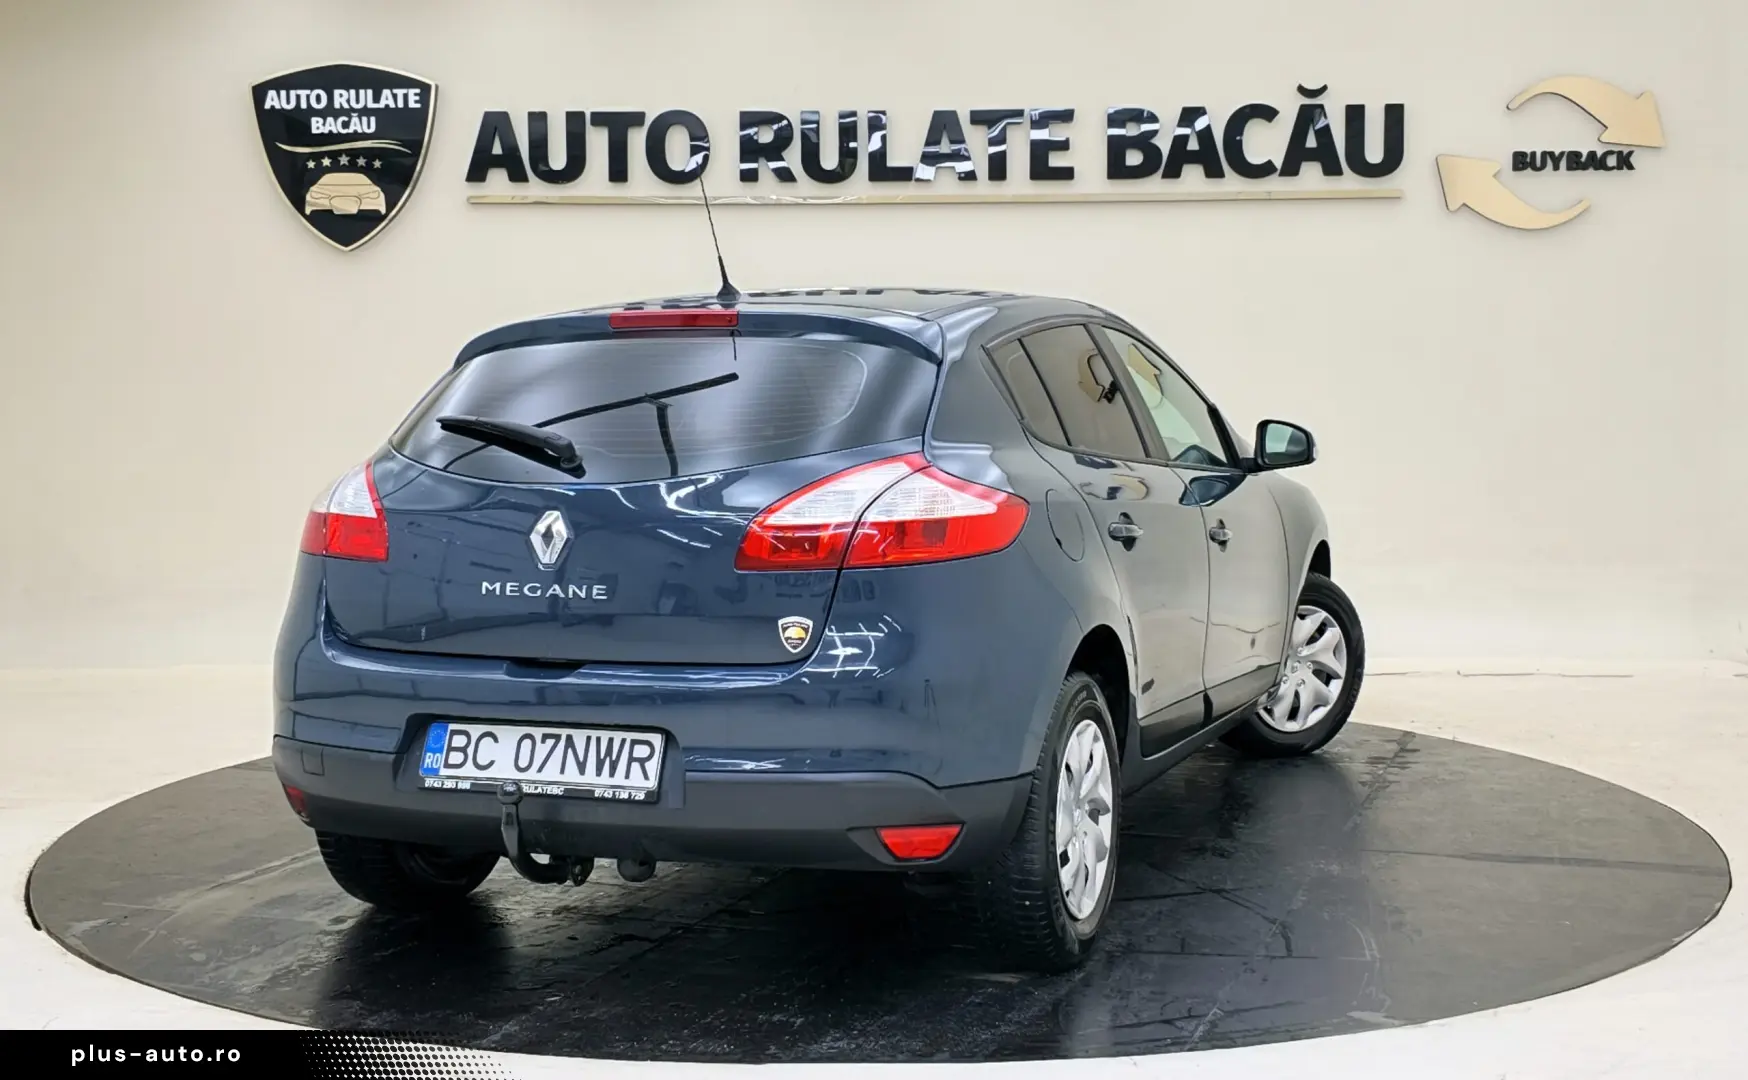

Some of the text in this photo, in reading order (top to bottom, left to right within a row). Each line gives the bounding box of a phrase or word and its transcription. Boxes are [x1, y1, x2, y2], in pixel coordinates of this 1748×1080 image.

[264, 88, 422, 110] AUTO RULATE
[310, 112, 376, 134] BACĂU
[466, 84, 1405, 185] AUTO RULATE BACĂU
[1511, 150, 1636, 172] BUYBACK
[481, 581, 608, 600] MEGANE
[424, 752, 443, 770] RO
[443, 729, 656, 781] BC 07NWR
